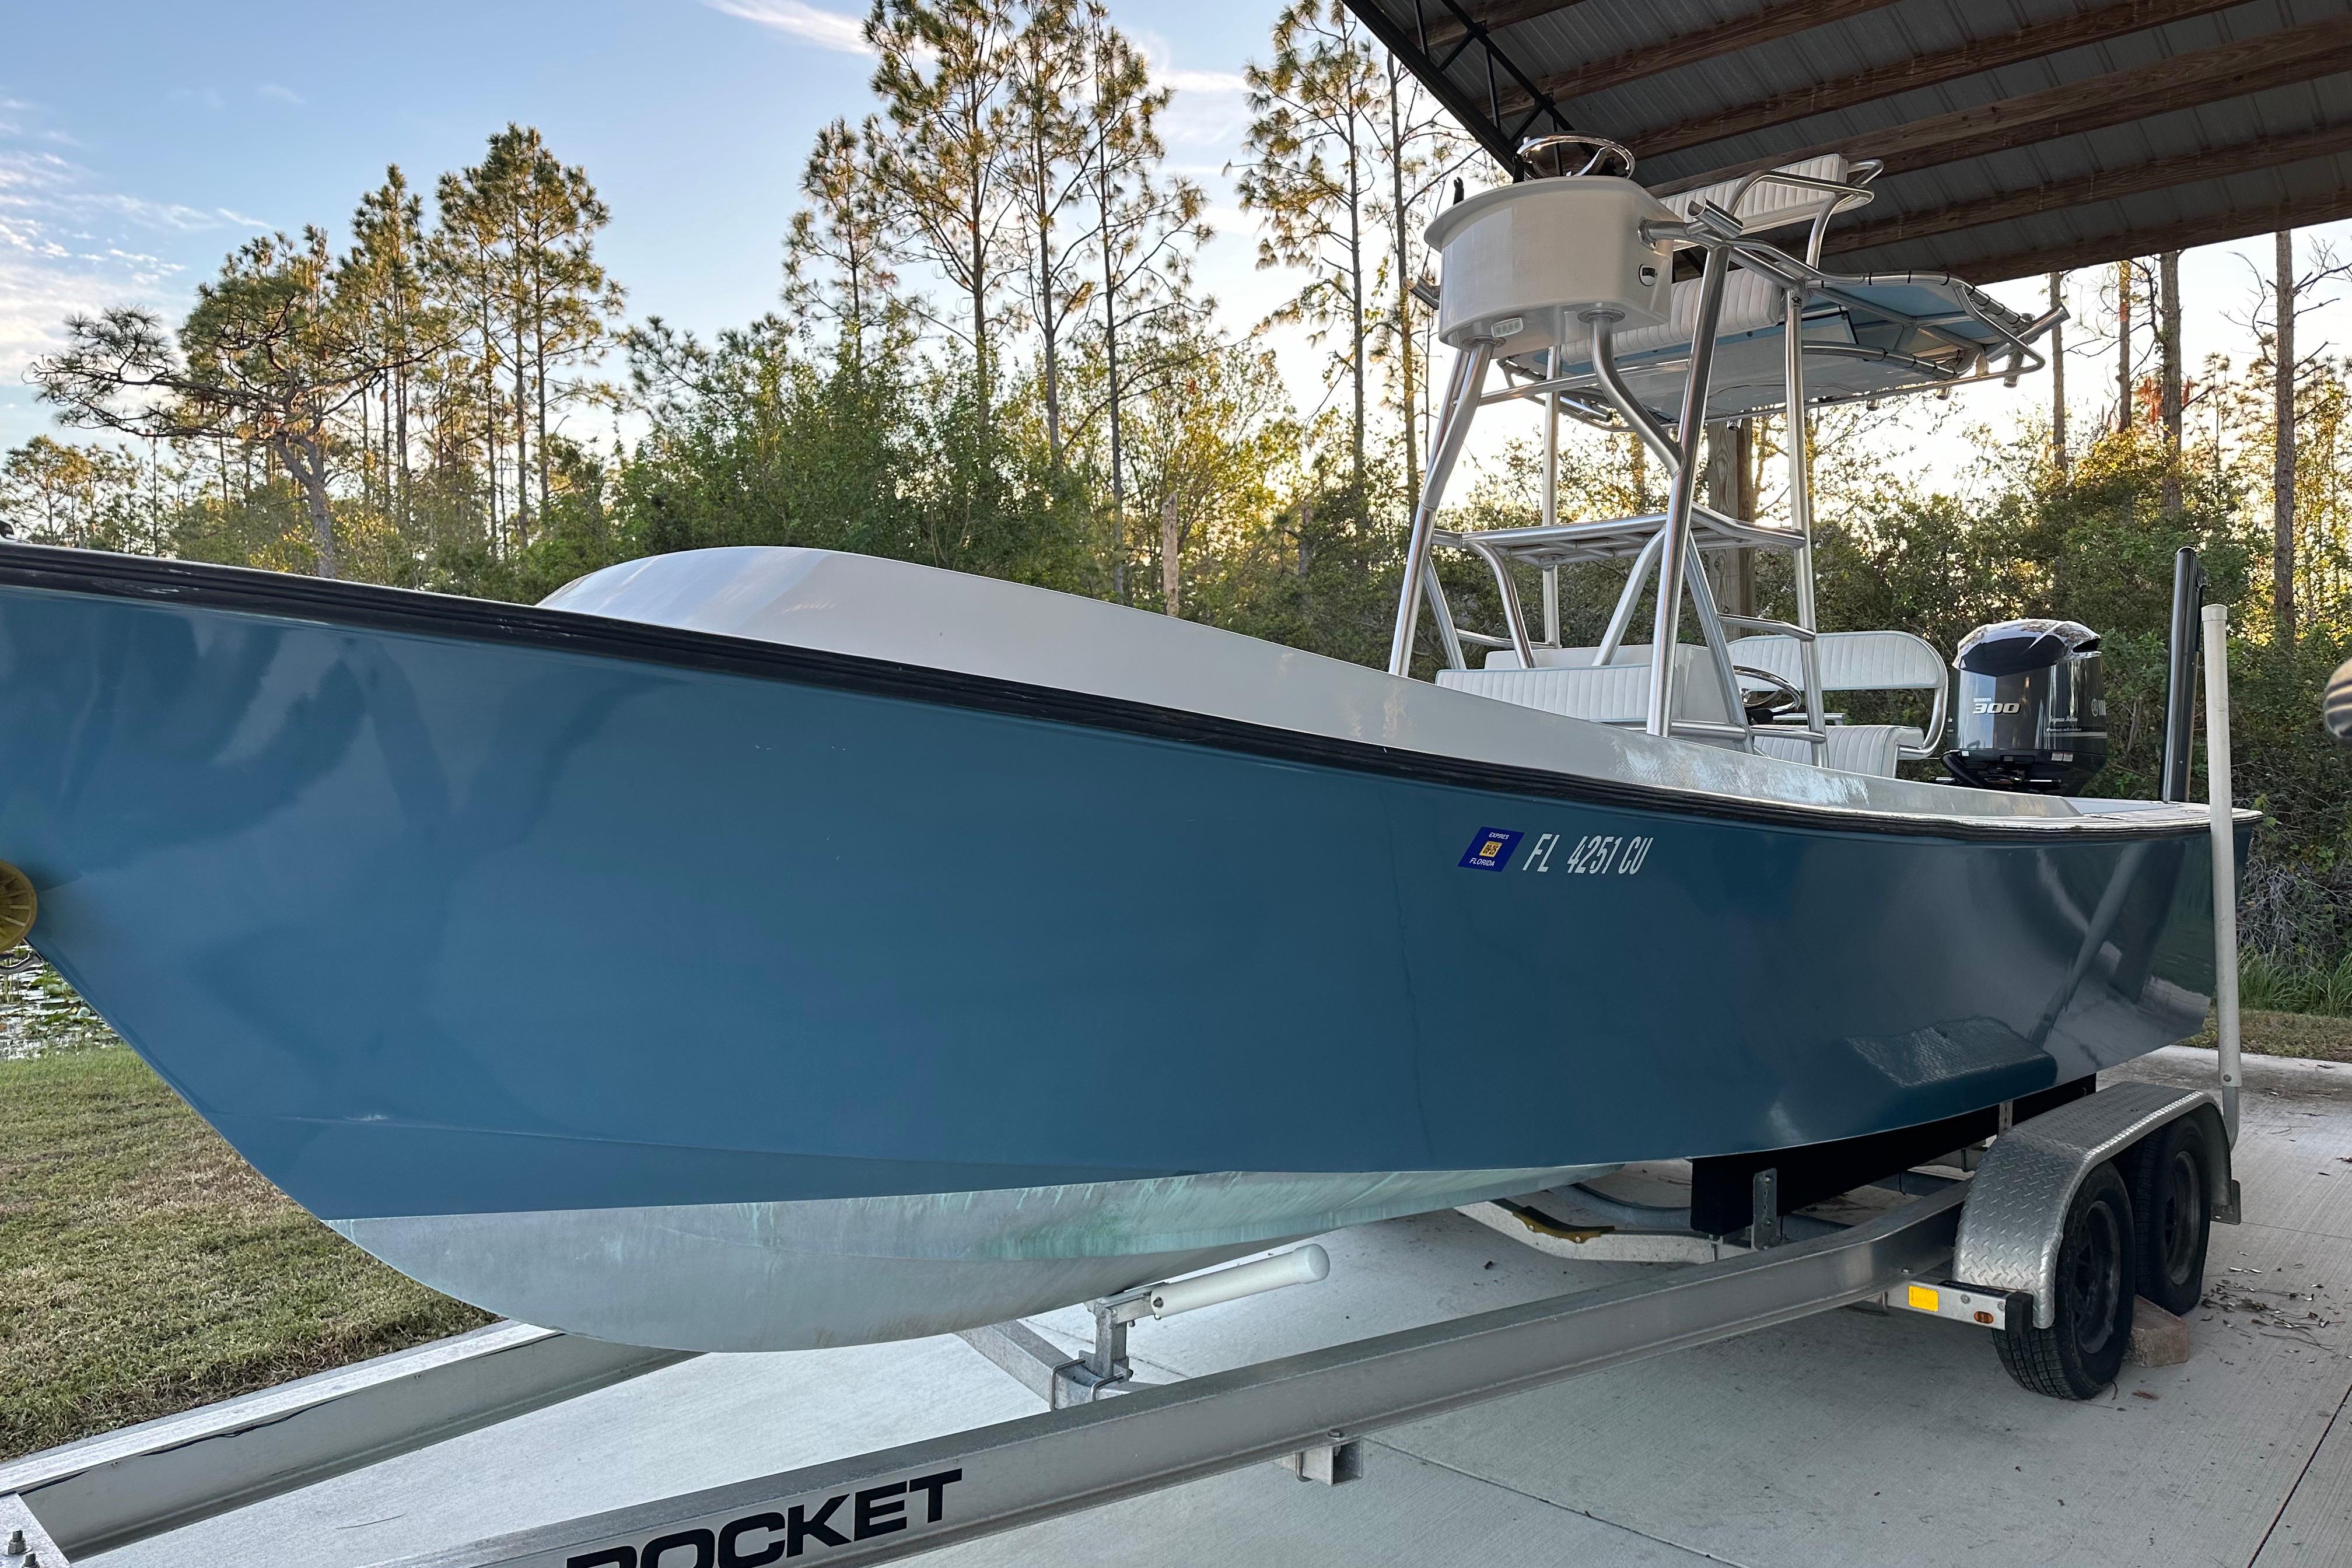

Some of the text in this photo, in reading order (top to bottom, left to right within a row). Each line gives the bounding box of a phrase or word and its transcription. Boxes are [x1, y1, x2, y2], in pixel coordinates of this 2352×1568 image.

[1972, 703, 2021, 714] 300
[1488, 832, 1510, 840] EXPIRES
[1522, 834, 1654, 875] FL 4251 CU
[1469, 858, 1495, 867] FLORIDA
